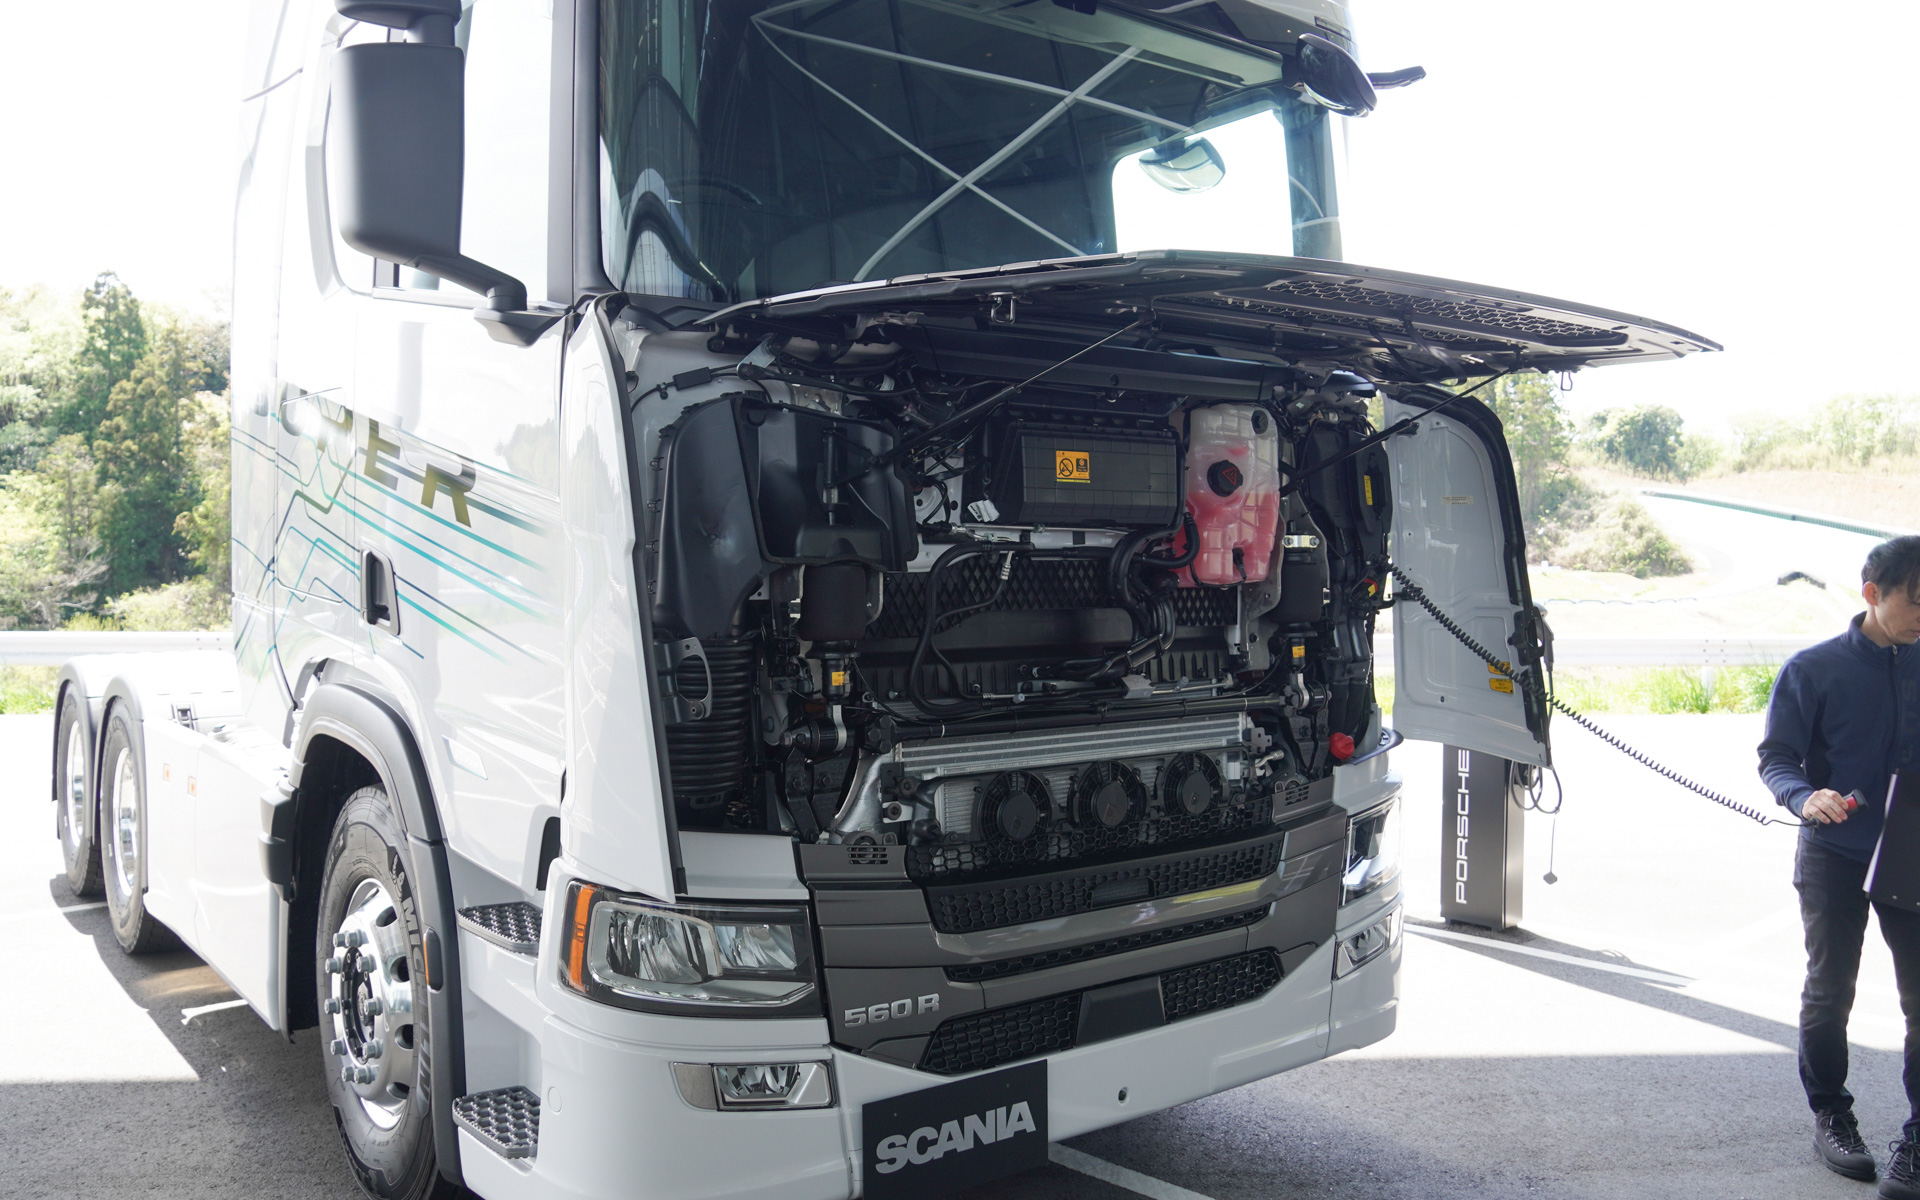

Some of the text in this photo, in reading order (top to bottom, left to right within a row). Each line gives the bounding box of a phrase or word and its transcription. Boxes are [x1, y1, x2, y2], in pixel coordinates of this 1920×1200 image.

[252, 380, 477, 527] UPER
[1455, 749, 1470, 904] PORSCHE
[844, 992, 940, 1028] 560 R
[875, 1101, 1036, 1174] SCANIA
